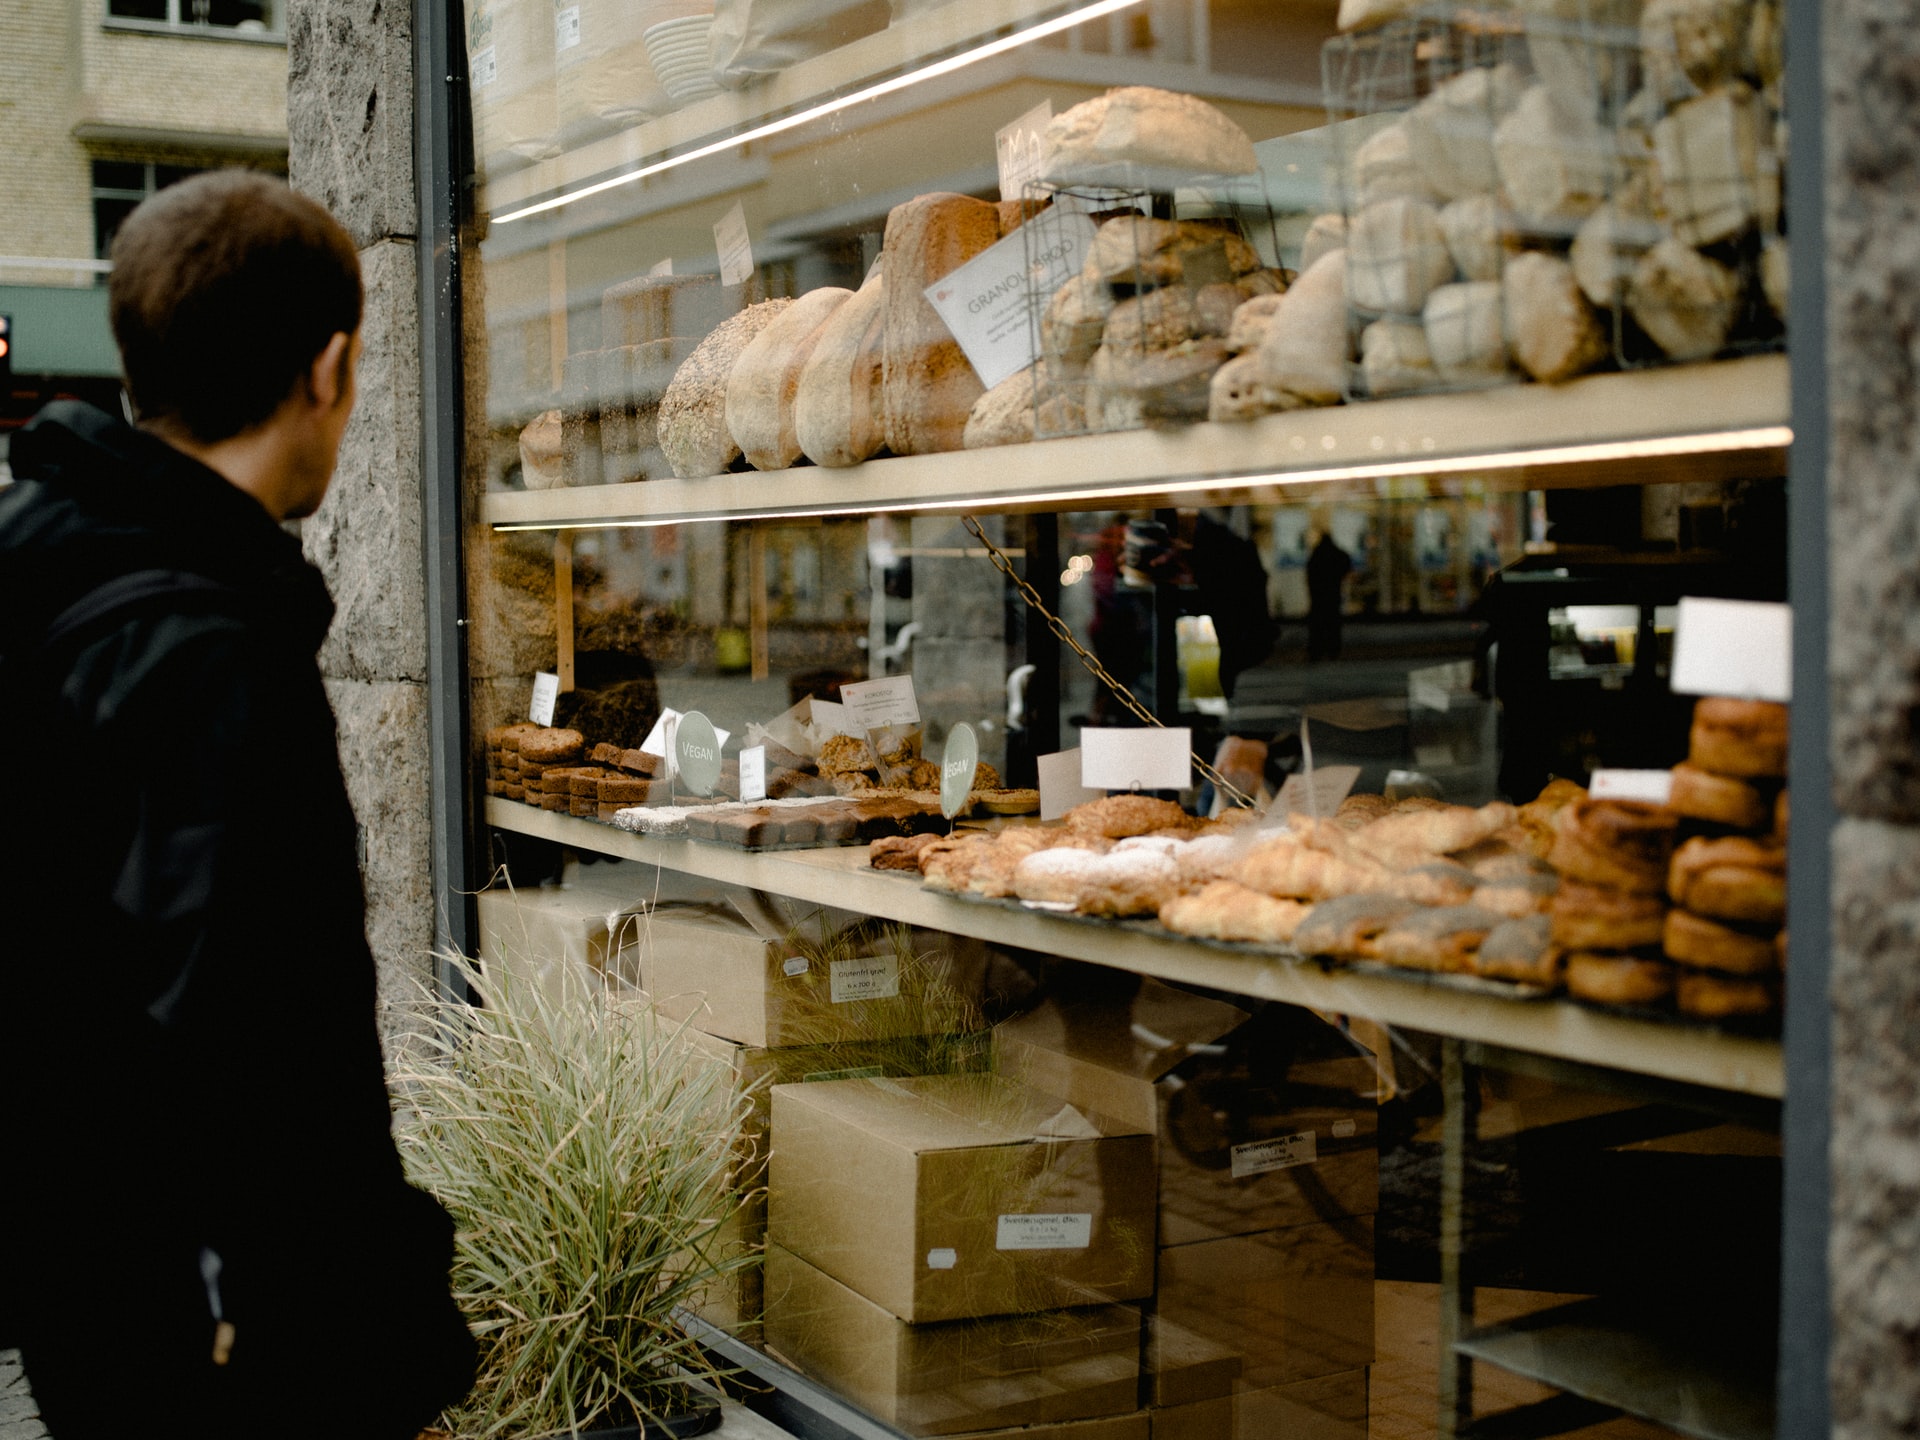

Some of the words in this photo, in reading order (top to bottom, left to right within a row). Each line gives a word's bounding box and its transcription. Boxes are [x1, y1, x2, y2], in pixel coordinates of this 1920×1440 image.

[968, 240, 1072, 313] GRANOLBRØD
[681, 741, 713, 761] VEGAN
[944, 757, 969, 780] VEGAN
[838, 969, 868, 978] Glutenfri
